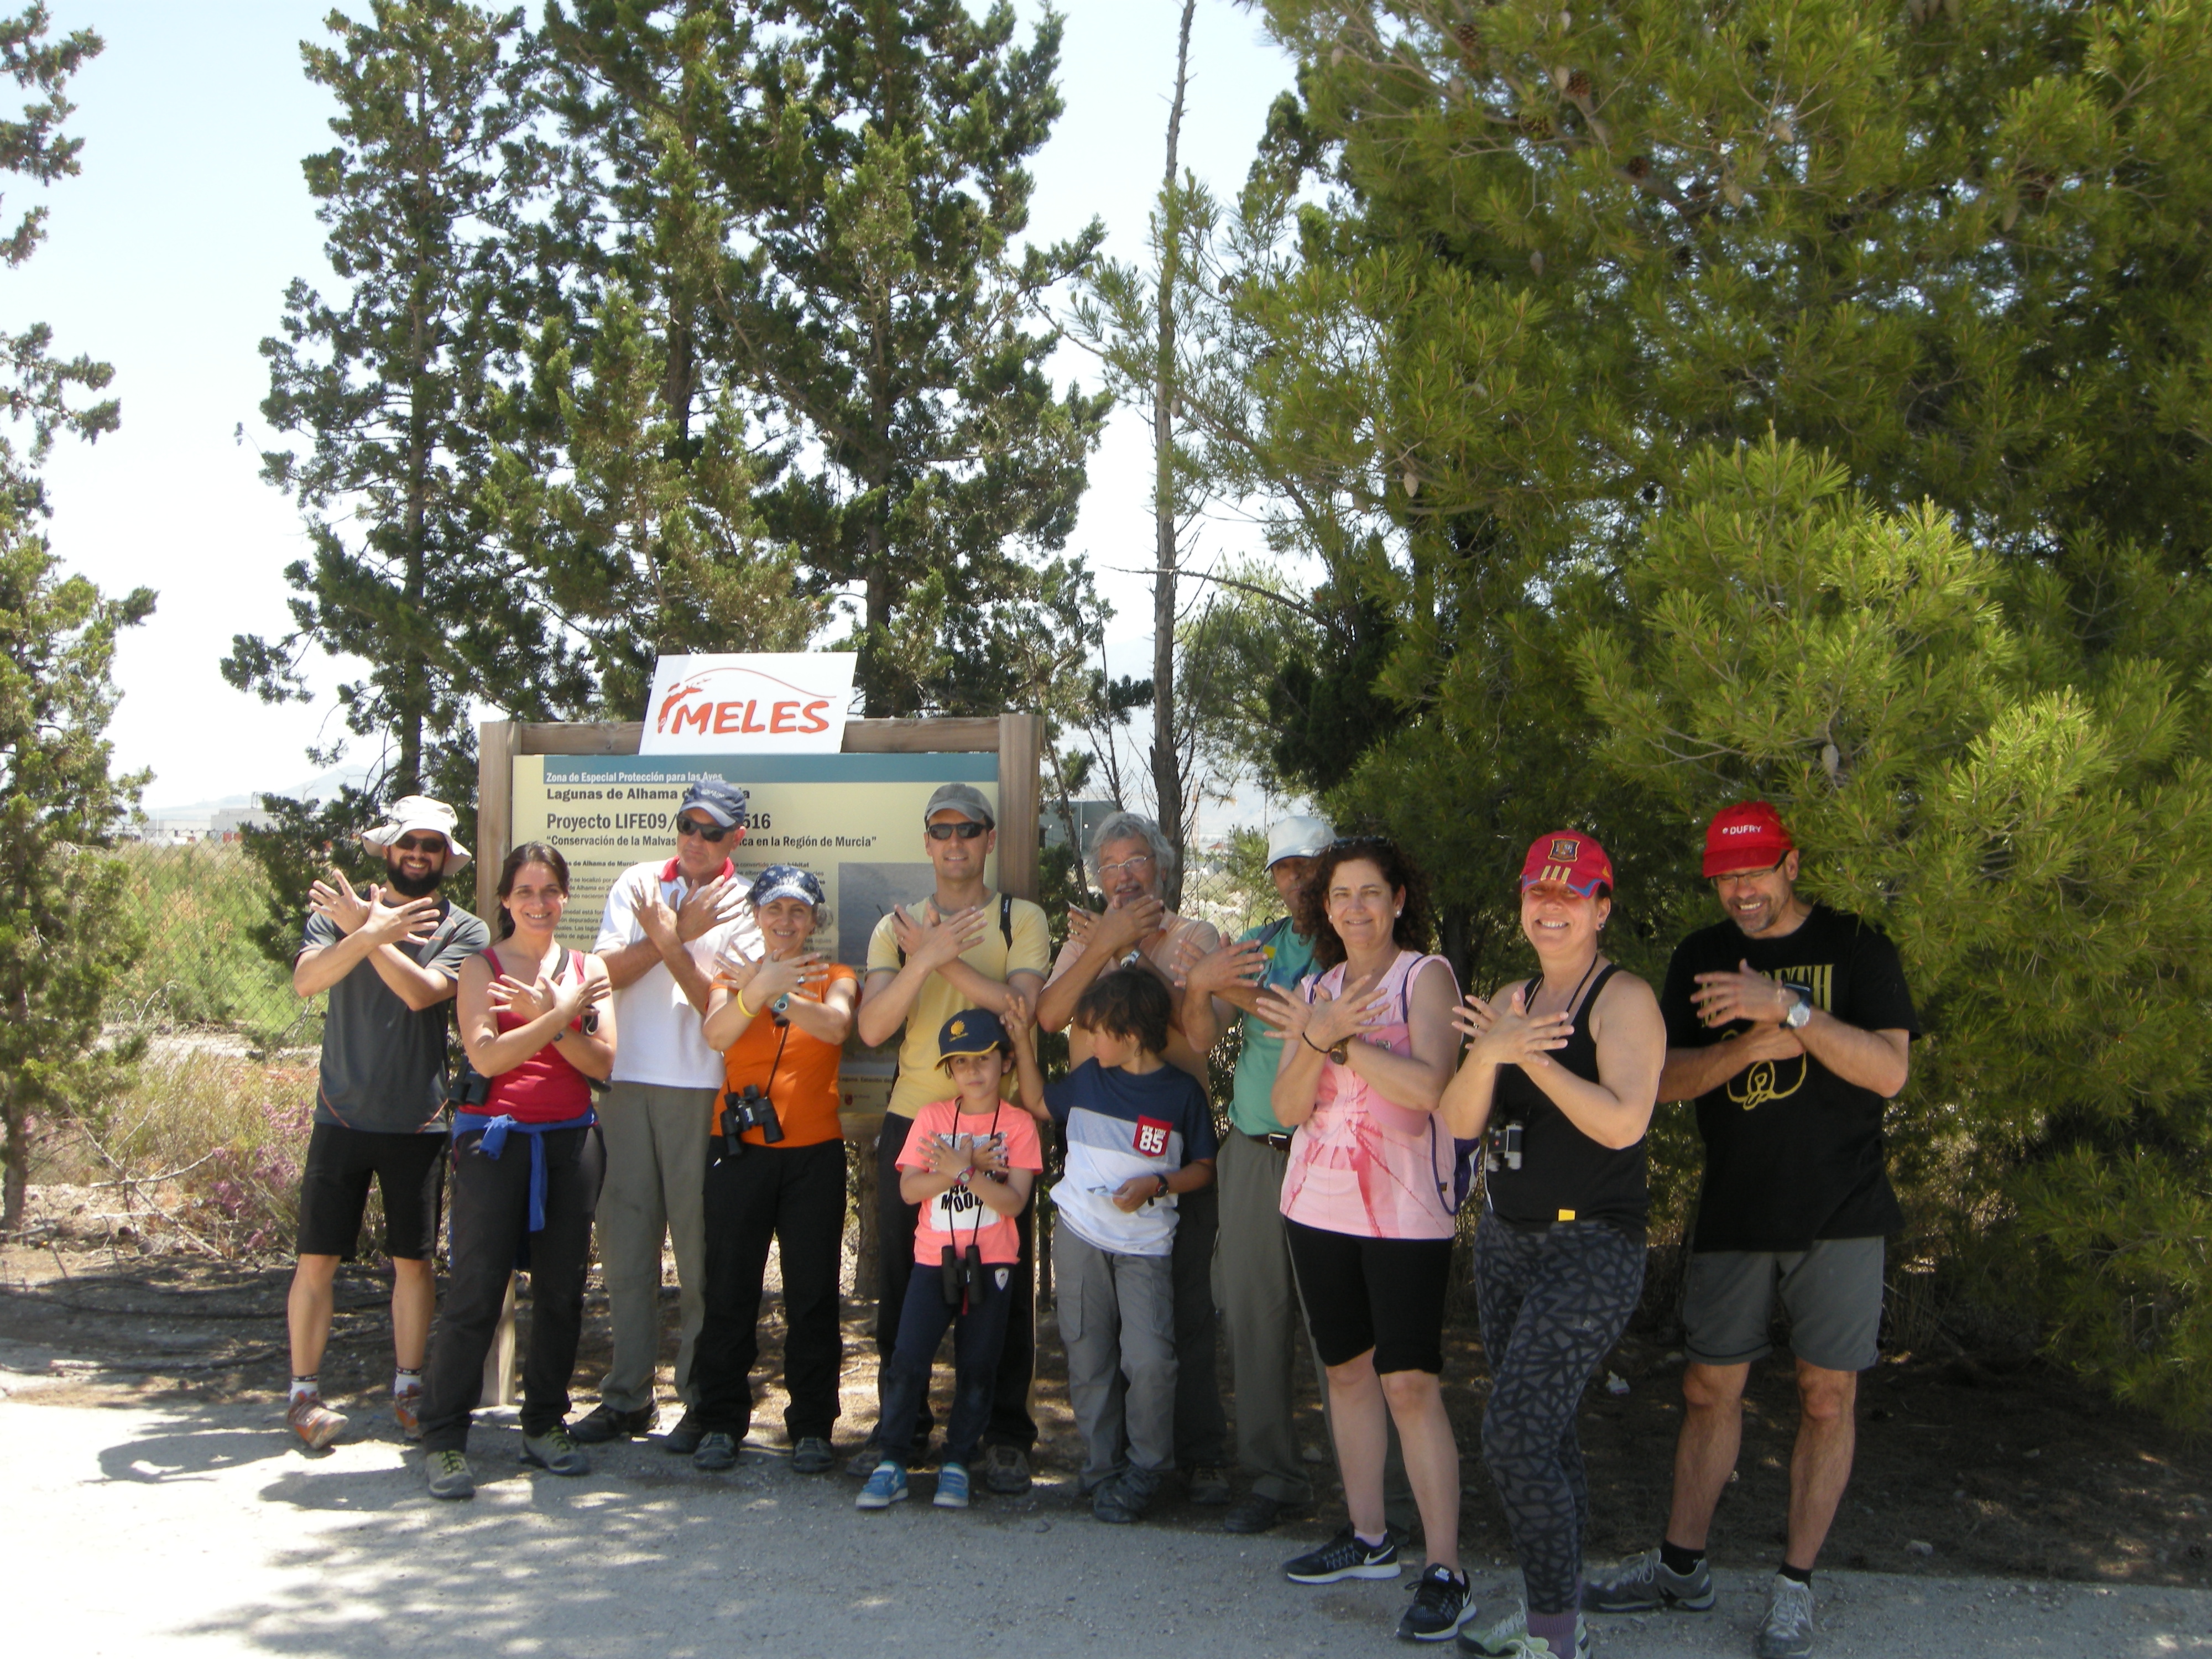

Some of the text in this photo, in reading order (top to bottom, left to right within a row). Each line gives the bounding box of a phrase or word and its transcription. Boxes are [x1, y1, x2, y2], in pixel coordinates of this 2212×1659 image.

[671, 699, 830, 735] MELES
[546, 771, 723, 784] Zona de Especial Protección para las Aves
[547, 788, 602, 802] Lagunas
[606, 788, 623, 800] de
[627, 788, 677, 800] Alhama
[547, 813, 611, 832] Proyecto
[1730, 825, 1761, 835] DUFRY
[617, 836, 629, 846] de
[631, 836, 640, 846] la
[642, 836, 676, 846] Malvas
[757, 838, 768, 846] en
[771, 836, 780, 846] la
[783, 835, 817, 849] Región
[820, 836, 832, 847] de
[1139, 1131, 1164, 1154] 85
